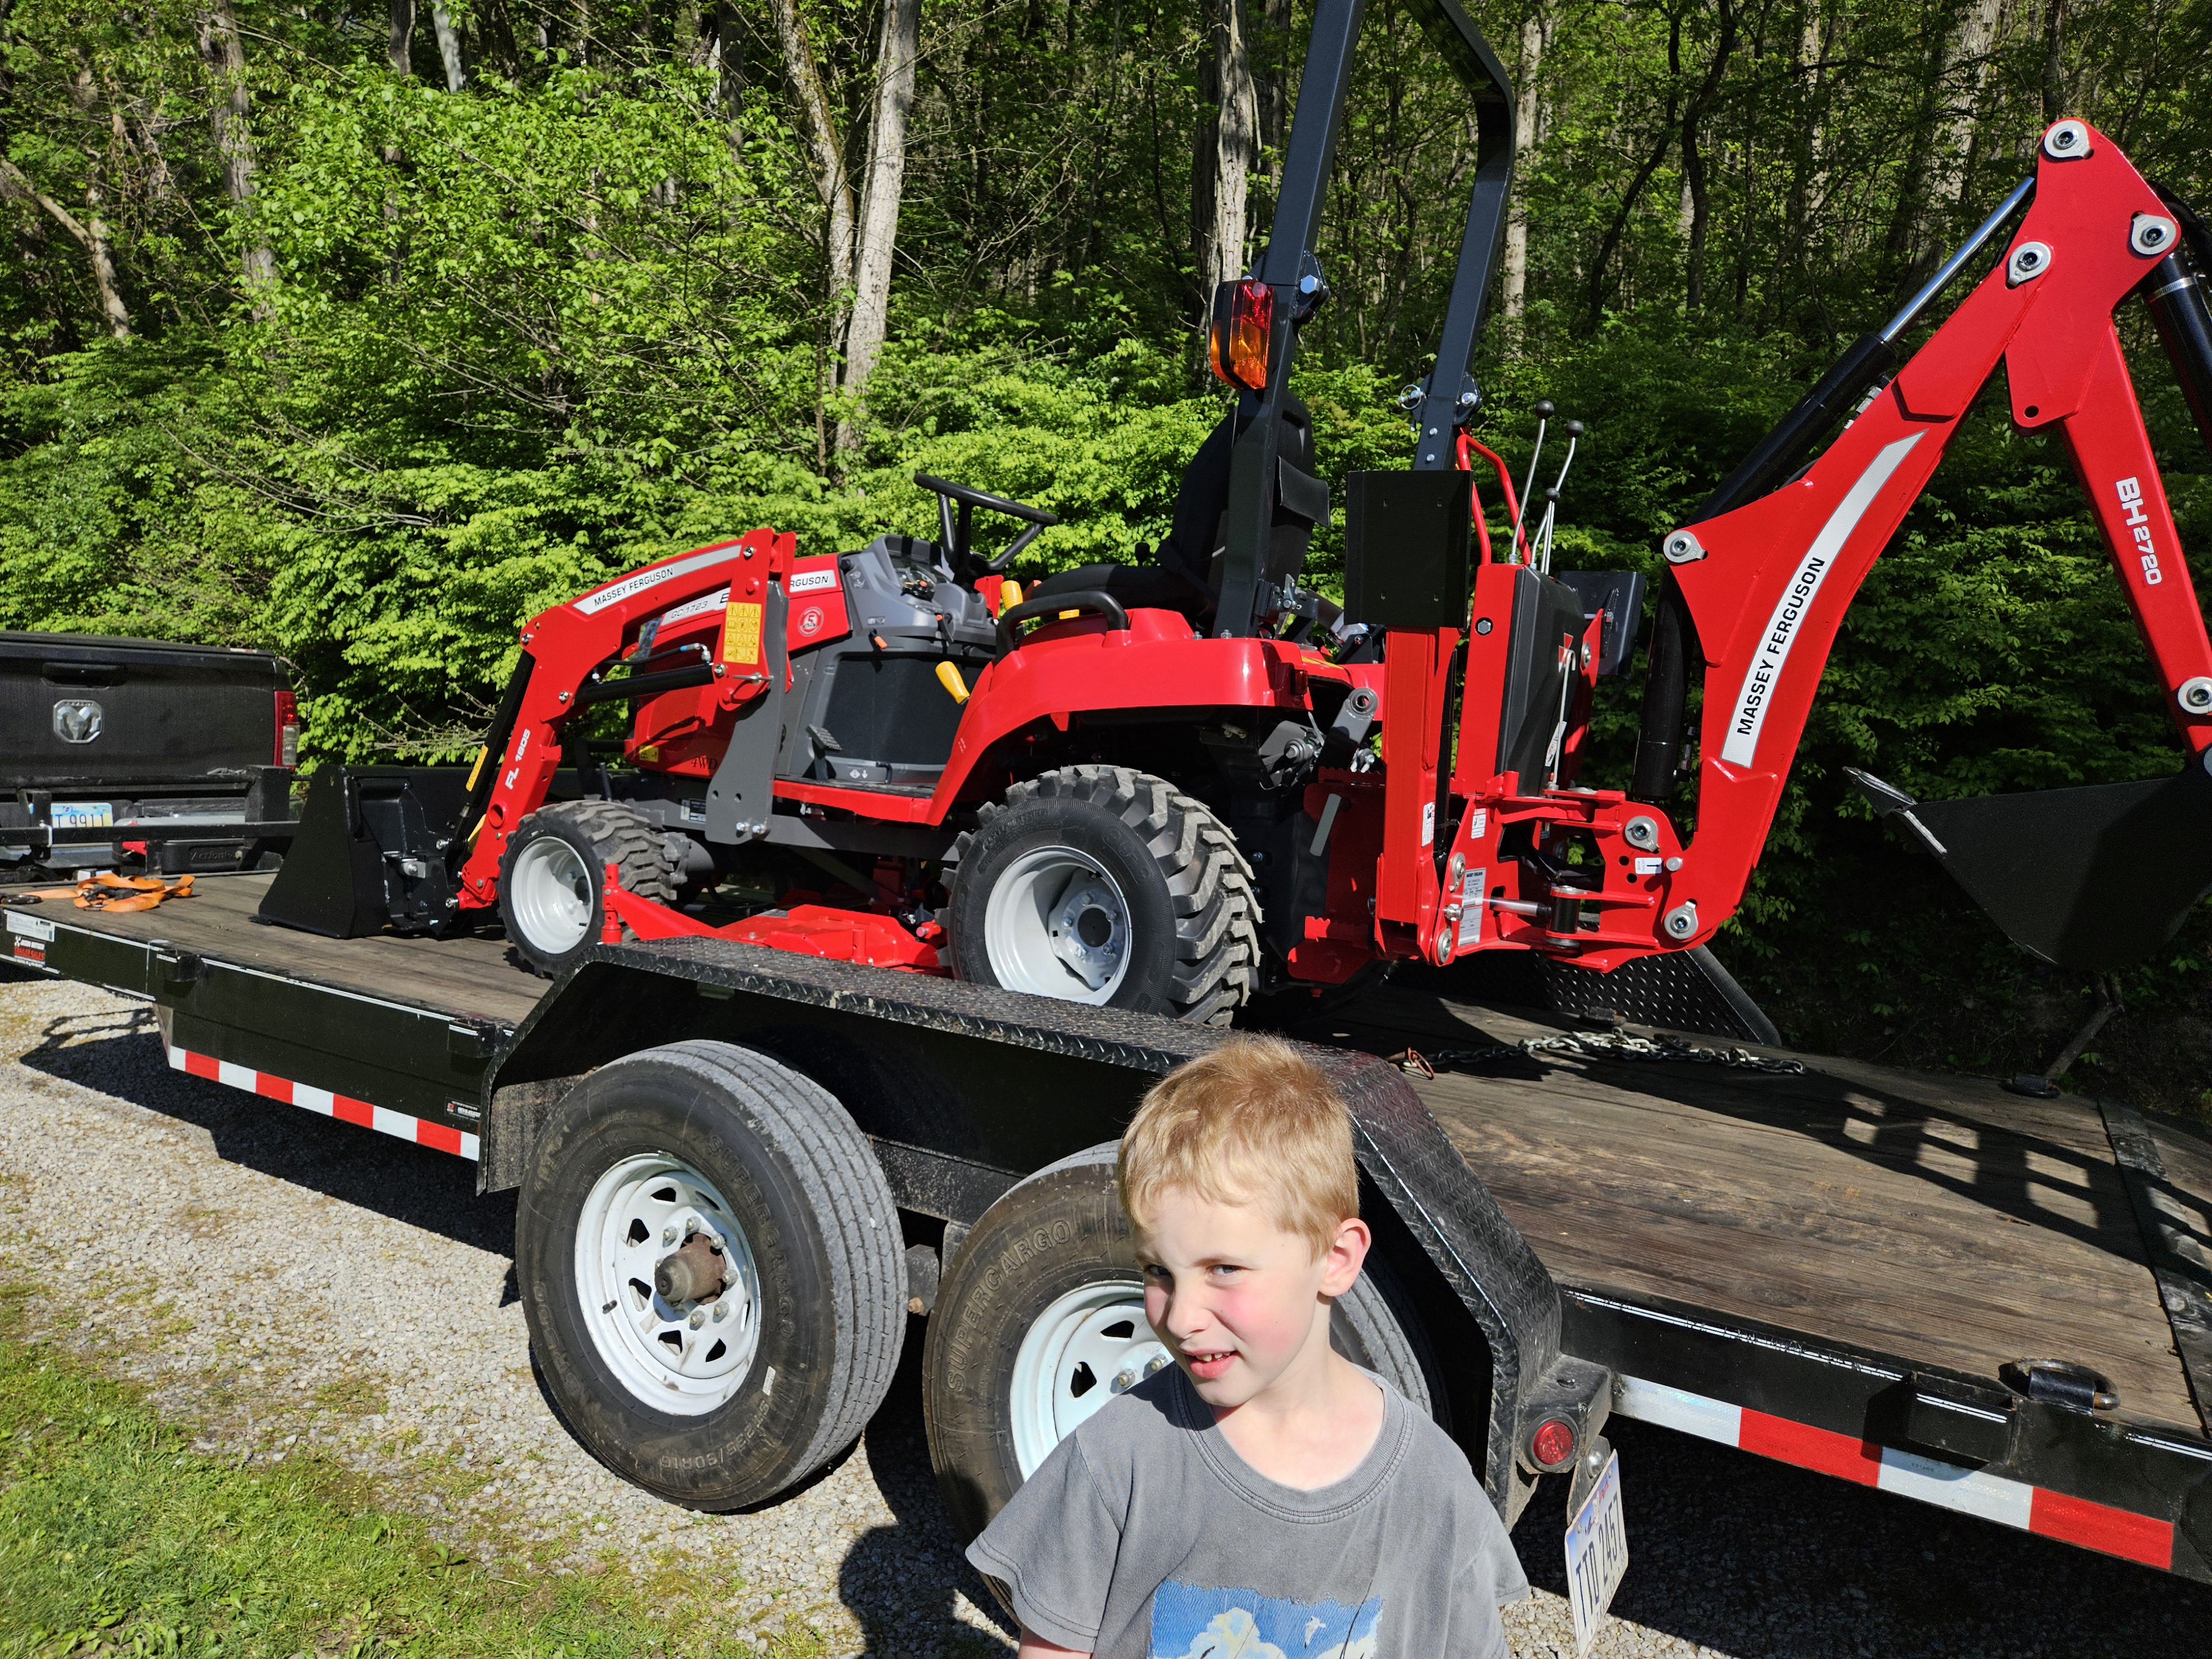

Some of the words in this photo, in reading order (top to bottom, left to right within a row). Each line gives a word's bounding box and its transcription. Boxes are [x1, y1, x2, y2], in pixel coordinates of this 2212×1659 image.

[594, 585, 627, 607] MASSEY
[629, 567, 674, 592] FERGUSON
[671, 609, 682, 619] GC
[686, 601, 708, 614] 1723
[790, 575, 829, 587] RGUSON
[1737, 659, 1774, 735] MASSEY
[1767, 557, 1825, 655] FERGUSON
[505, 767, 520, 790] FL
[515, 728, 531, 762] 1805
[691, 757, 718, 770] 4WD
[707, 1134, 795, 1341] SUPERCARGO
[947, 1220, 1071, 1393] SUPERCARGO
[1576, 1541, 1599, 1629] TTD
[1599, 1490, 1621, 1586] 2457
